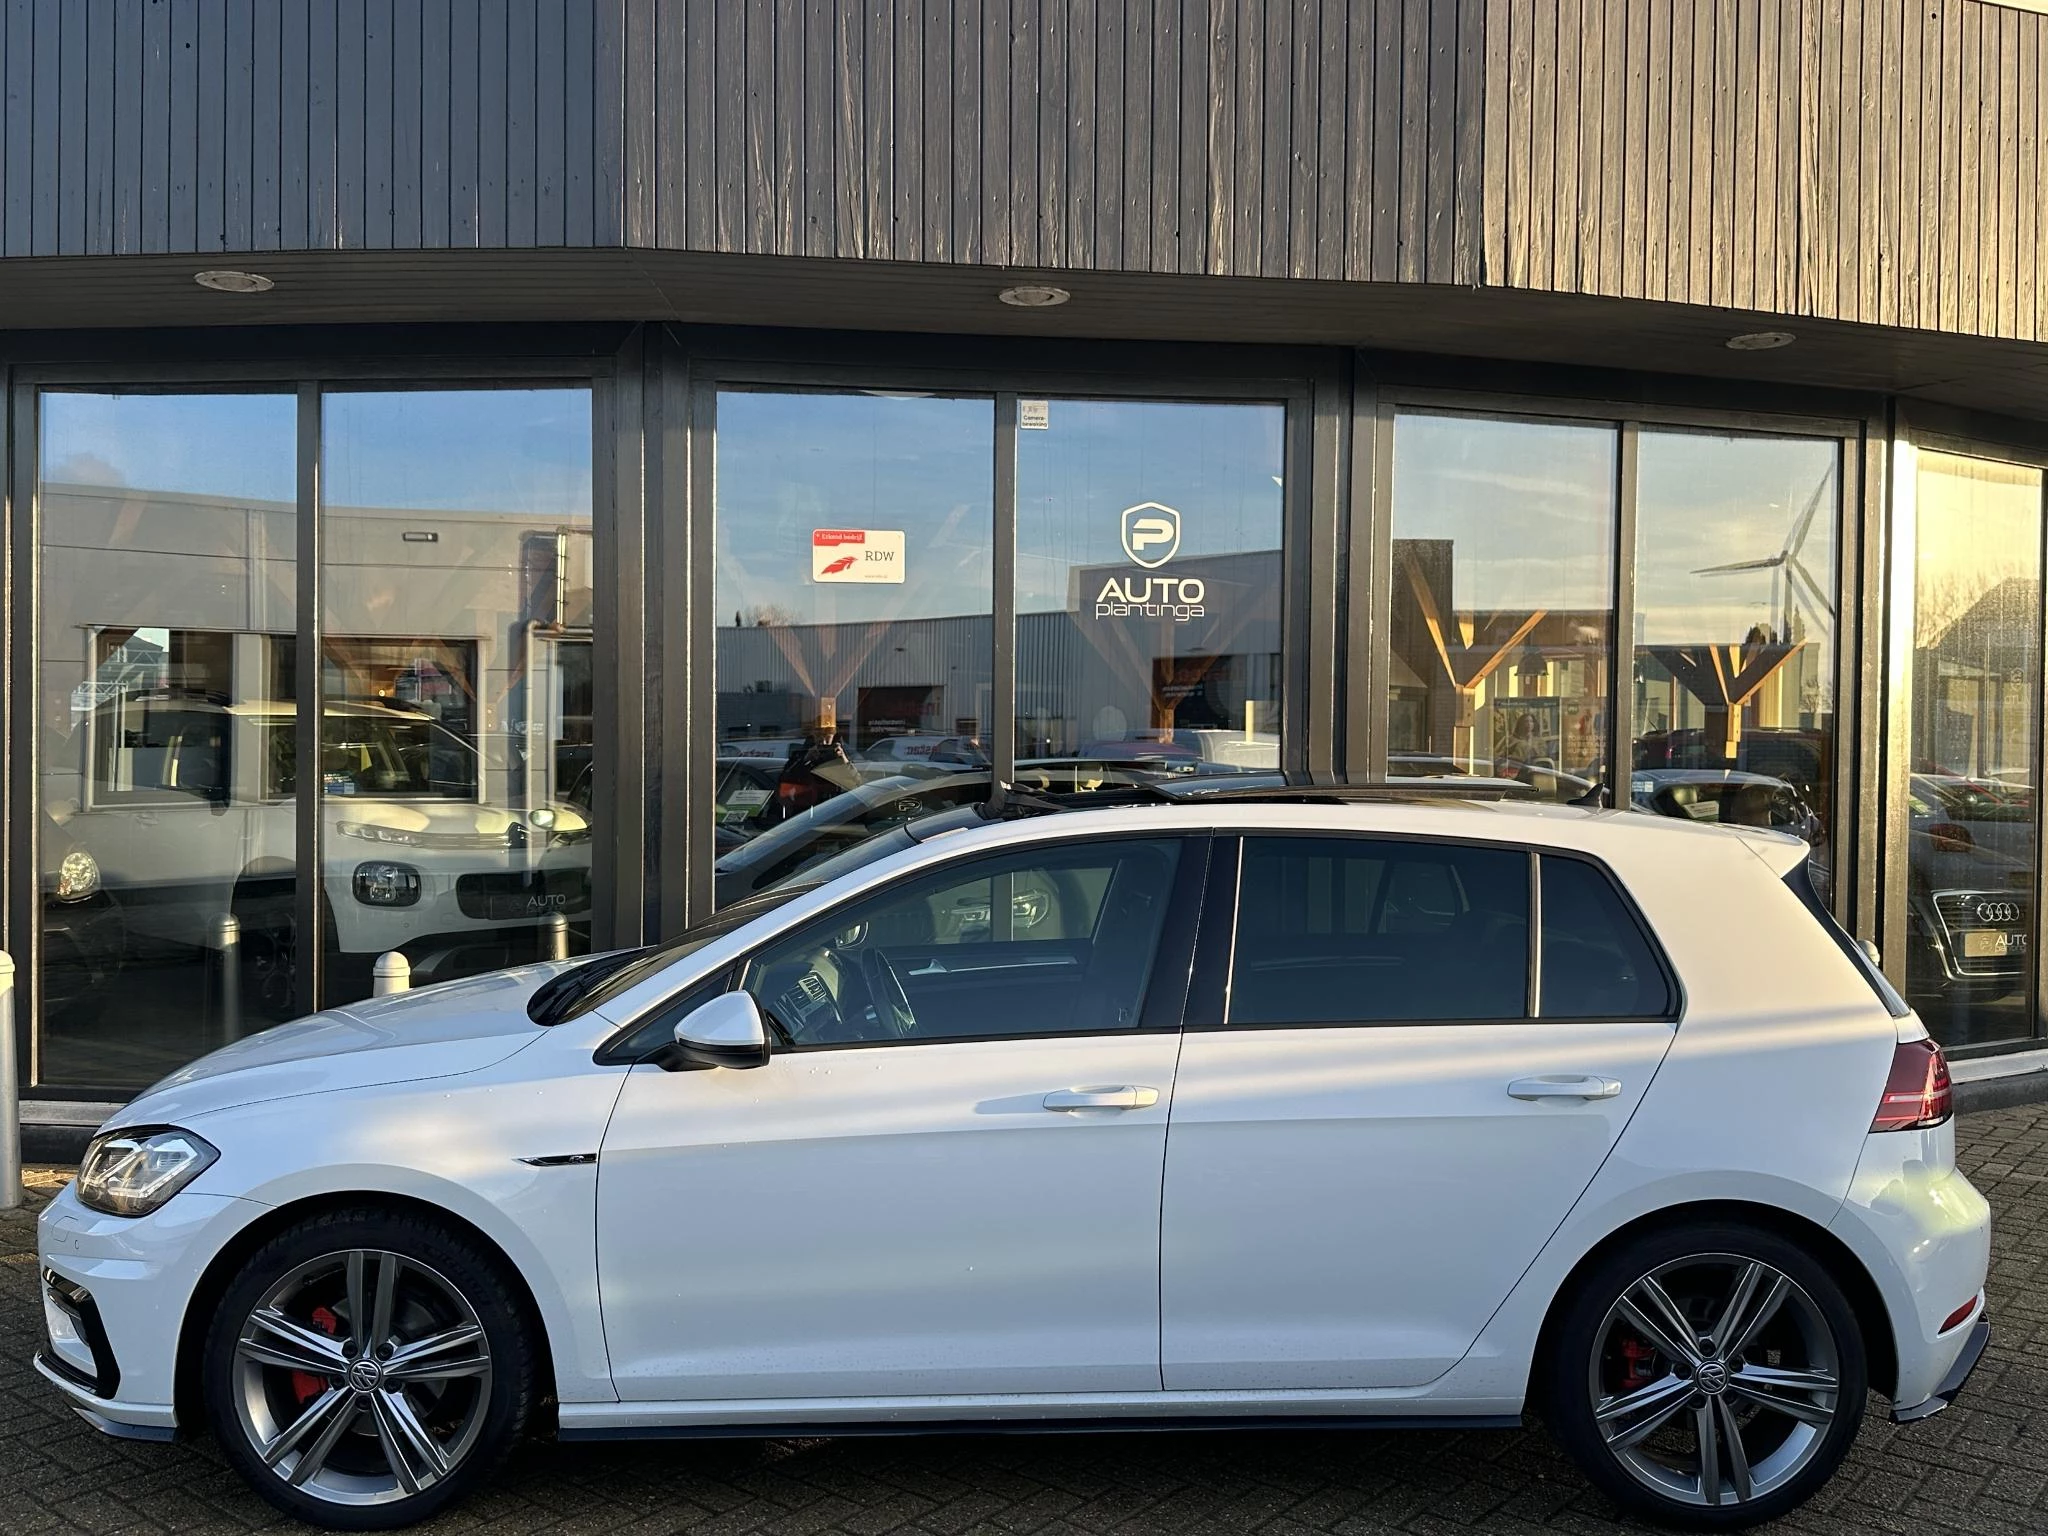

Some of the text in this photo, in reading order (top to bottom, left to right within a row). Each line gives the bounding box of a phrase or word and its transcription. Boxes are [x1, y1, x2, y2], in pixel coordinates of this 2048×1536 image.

[1132, 518, 1175, 551] P
[864, 550, 895, 562] RDW
[1096, 577, 1205, 604] AUTO
[1095, 601, 1205, 622] plantinga
[527, 894, 566, 908] AUTO
